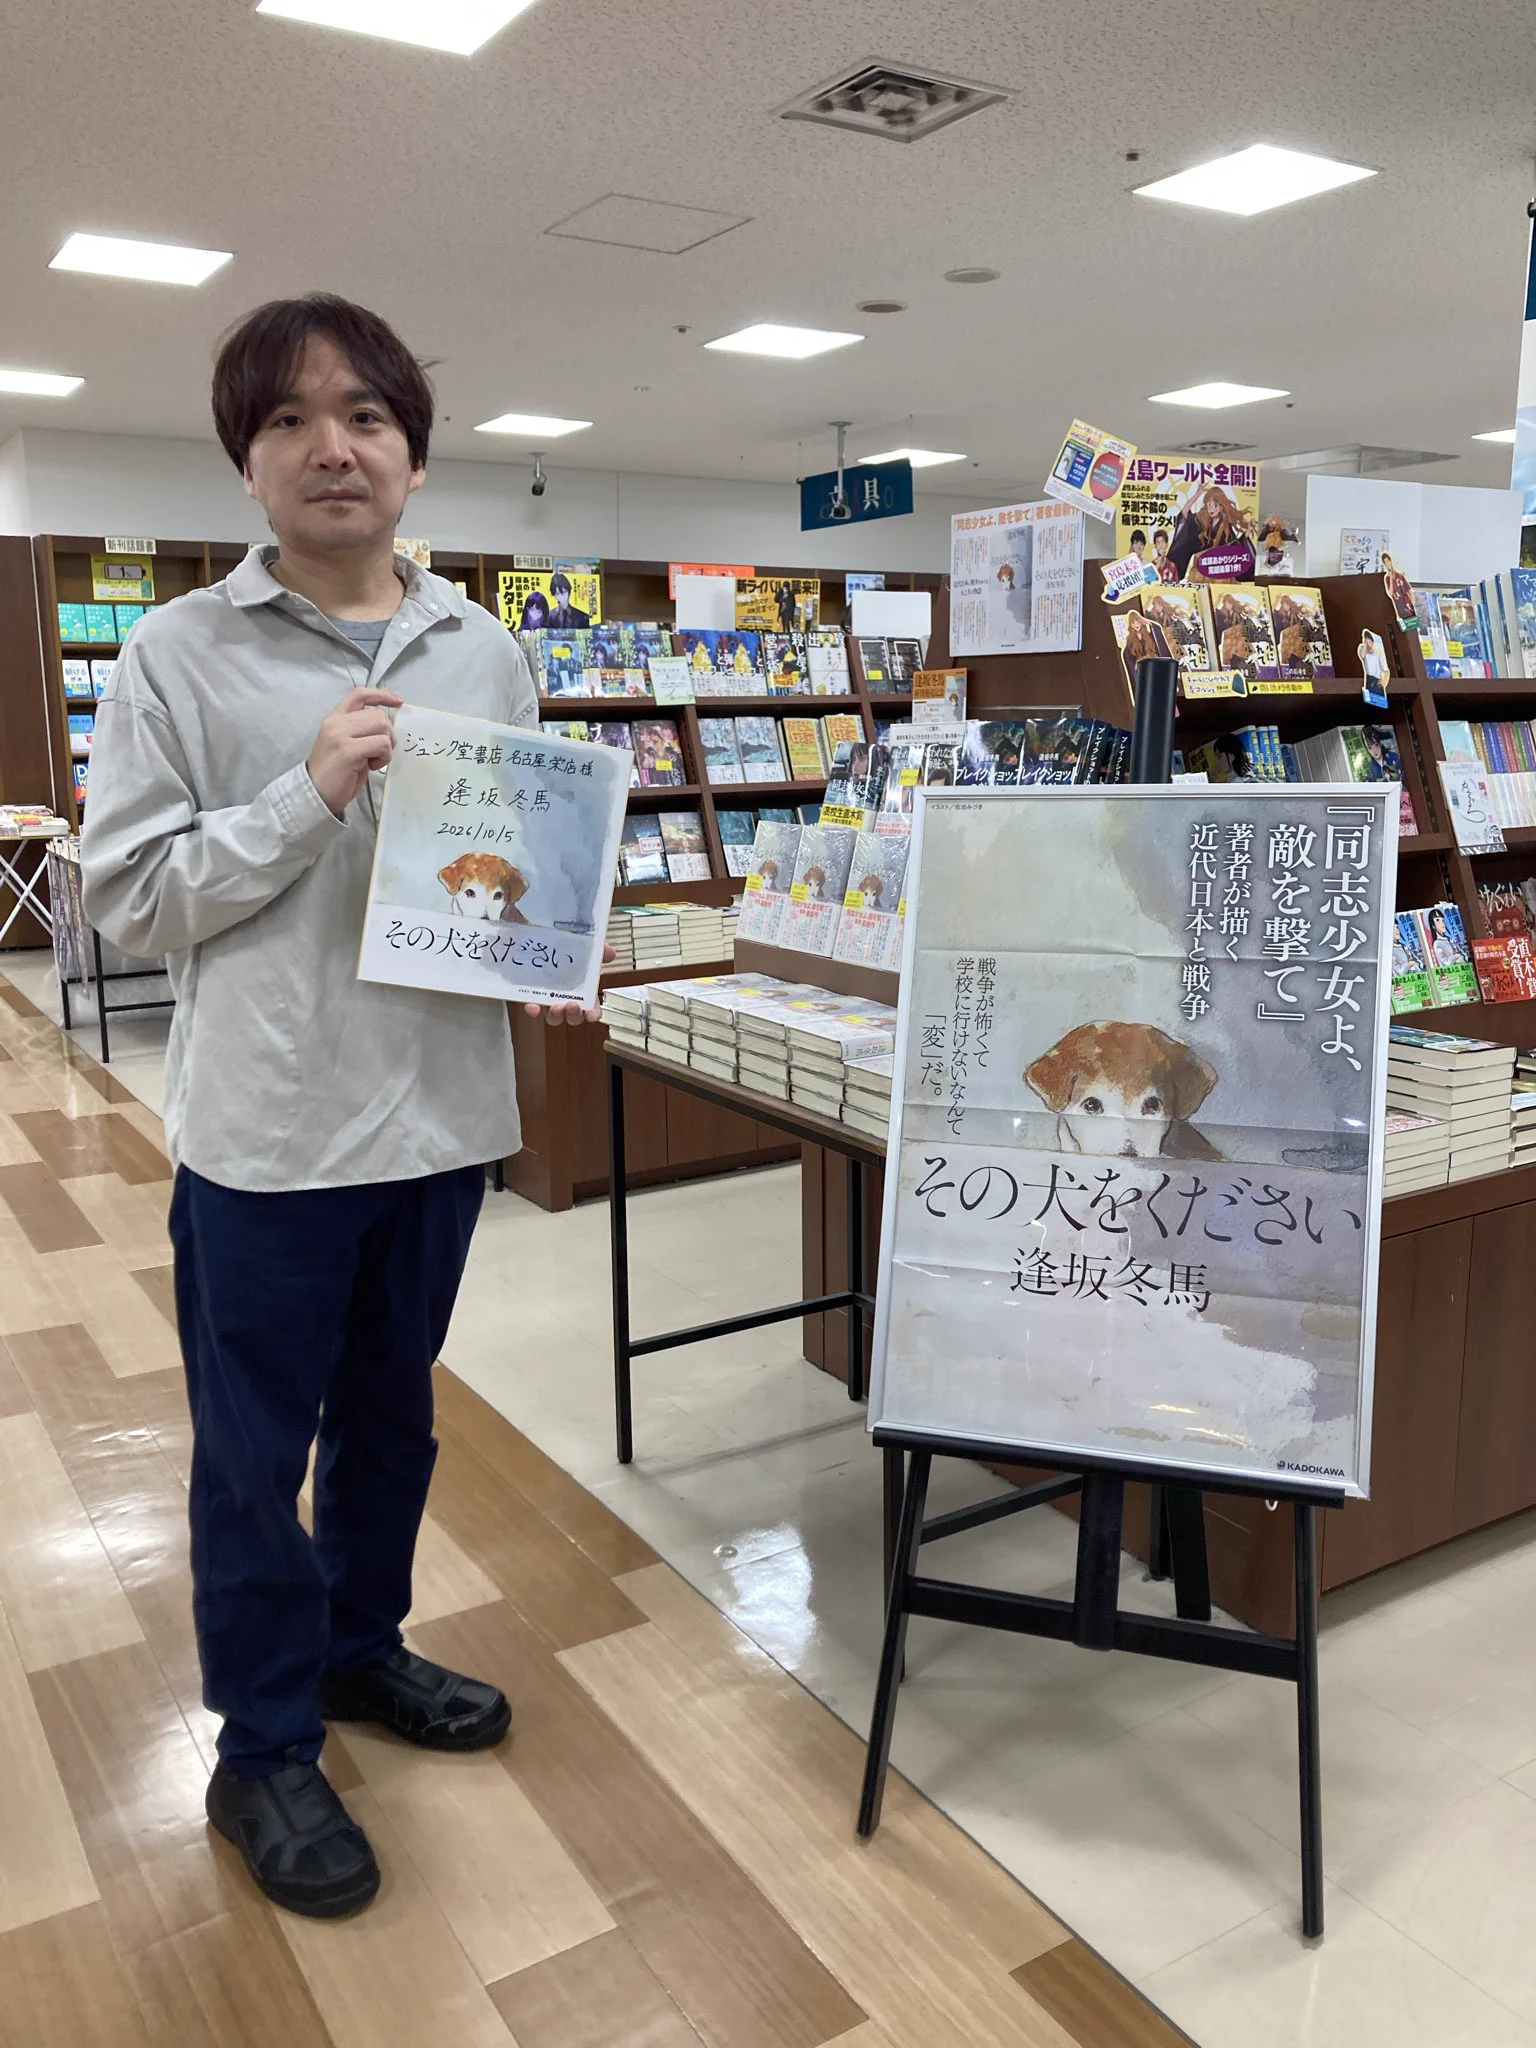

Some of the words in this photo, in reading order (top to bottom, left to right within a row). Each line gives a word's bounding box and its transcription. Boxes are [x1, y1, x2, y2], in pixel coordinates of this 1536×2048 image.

[1121, 501, 1167, 514] 予測不能の
[1121, 513, 1177, 527] 痛快エンタメ!
[107, 539, 154, 553] 新刊話題書
[502, 576, 516, 631] リターン
[403, 733, 503, 765] ジュンク堂書店
[505, 751, 593, 777] 名古屋栄店様
[443, 778, 550, 813] 逢坂冬馬
[437, 822, 515, 843] 2026/10/5
[1218, 823, 1255, 963] 著者が描く
[386, 920, 573, 968] その犬をください
[1180, 823, 1220, 1022] 近代日本と戦争
[1257, 823, 1317, 1022] 敵を撃て』
[1315, 805, 1375, 1072] 『同志少女よ、
[555, 993, 584, 1001] KADOKAWA
[973, 957, 997, 1068] 戦争が怖くて
[920, 1013, 946, 1098] 「変」だ。
[946, 957, 975, 1136] 学校に行けないなんて
[915, 1156, 1362, 1246] その犬をください
[1010, 1247, 1212, 1314] 逢坂冬馬
[1287, 1461, 1346, 1478] KADOKAWA
